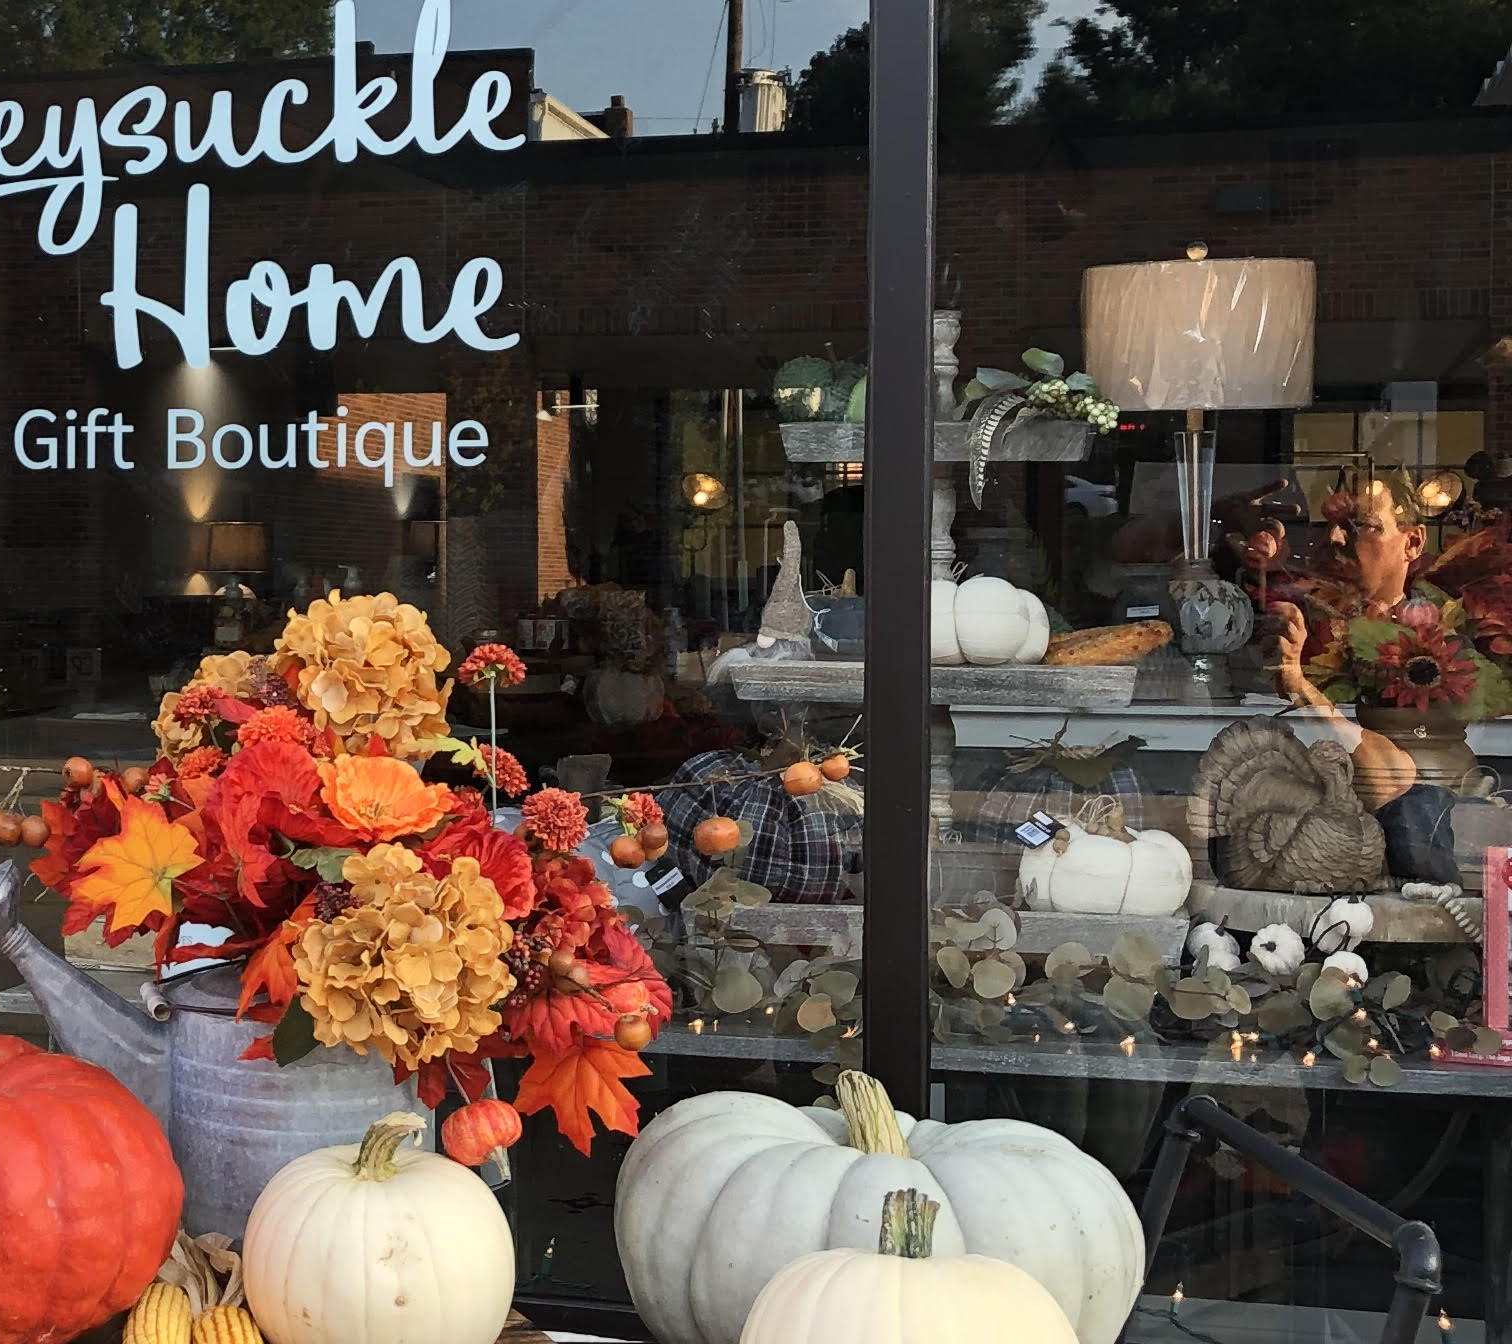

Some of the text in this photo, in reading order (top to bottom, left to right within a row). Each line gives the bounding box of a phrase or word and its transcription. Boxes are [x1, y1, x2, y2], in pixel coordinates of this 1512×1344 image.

[100, 183, 522, 370] Home
[13, 407, 135, 470] Gift
[167, 406, 489, 487] Boutique
